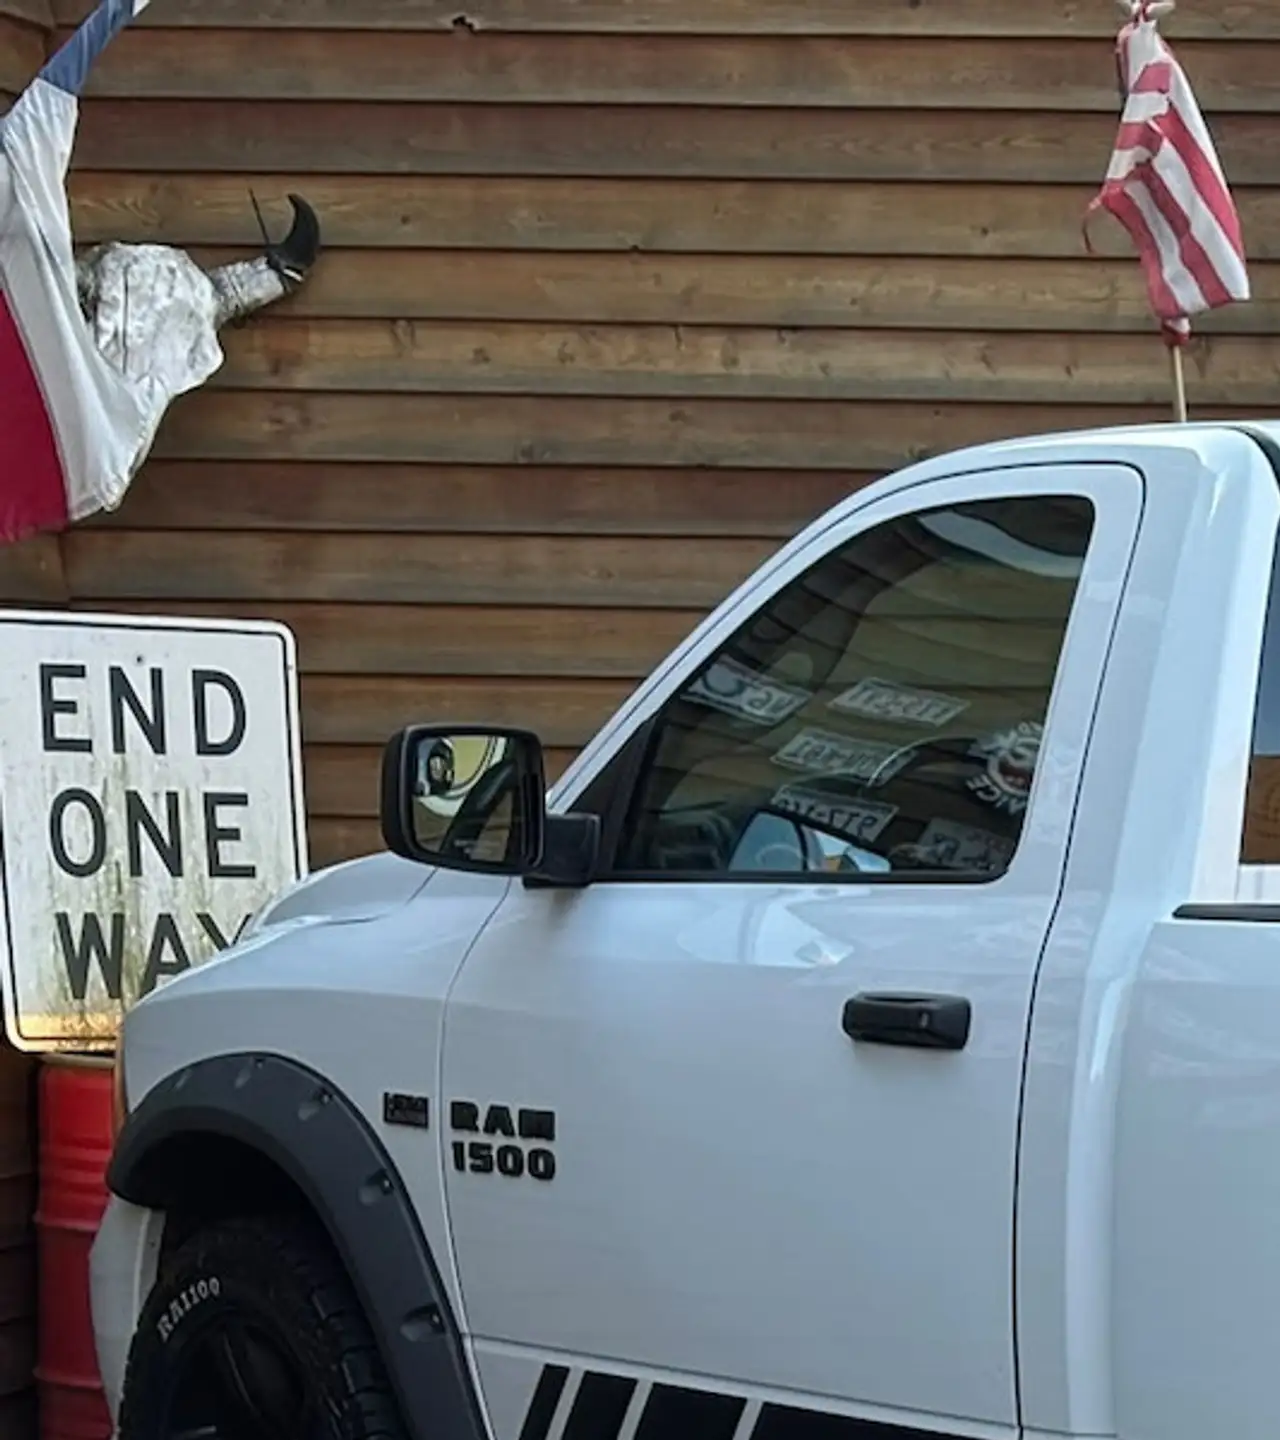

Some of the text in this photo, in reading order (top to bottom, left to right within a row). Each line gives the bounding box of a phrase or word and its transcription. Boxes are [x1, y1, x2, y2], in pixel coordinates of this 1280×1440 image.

[39, 662, 247, 756] END
[49, 787, 256, 878] ONE
[451, 1100, 555, 1141] RAM
[452, 1141, 556, 1181] 1500
